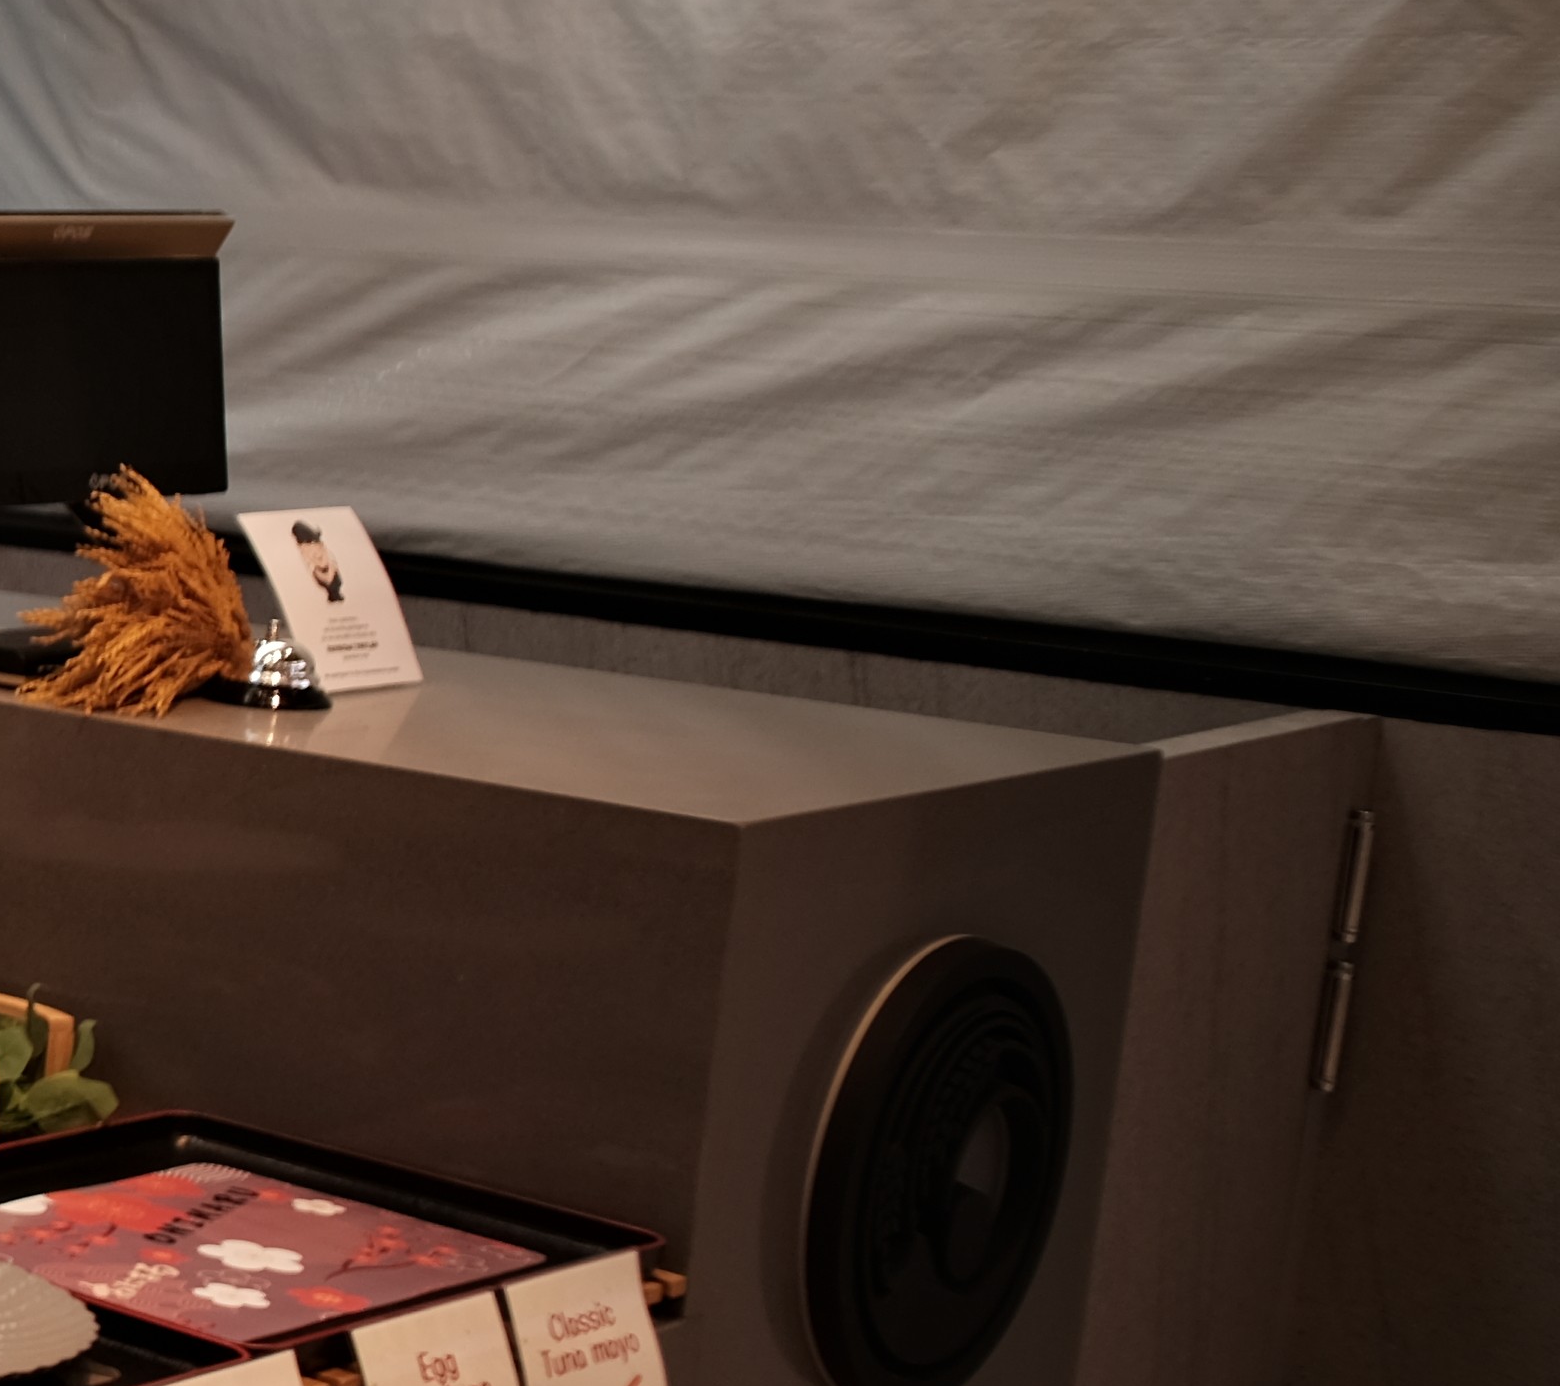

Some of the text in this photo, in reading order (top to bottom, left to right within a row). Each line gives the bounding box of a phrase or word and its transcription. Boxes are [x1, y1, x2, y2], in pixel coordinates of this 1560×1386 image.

[548, 1304, 616, 1342] Classic
[417, 1350, 460, 1386] Egg
[541, 1334, 641, 1380] Tuna mayo
